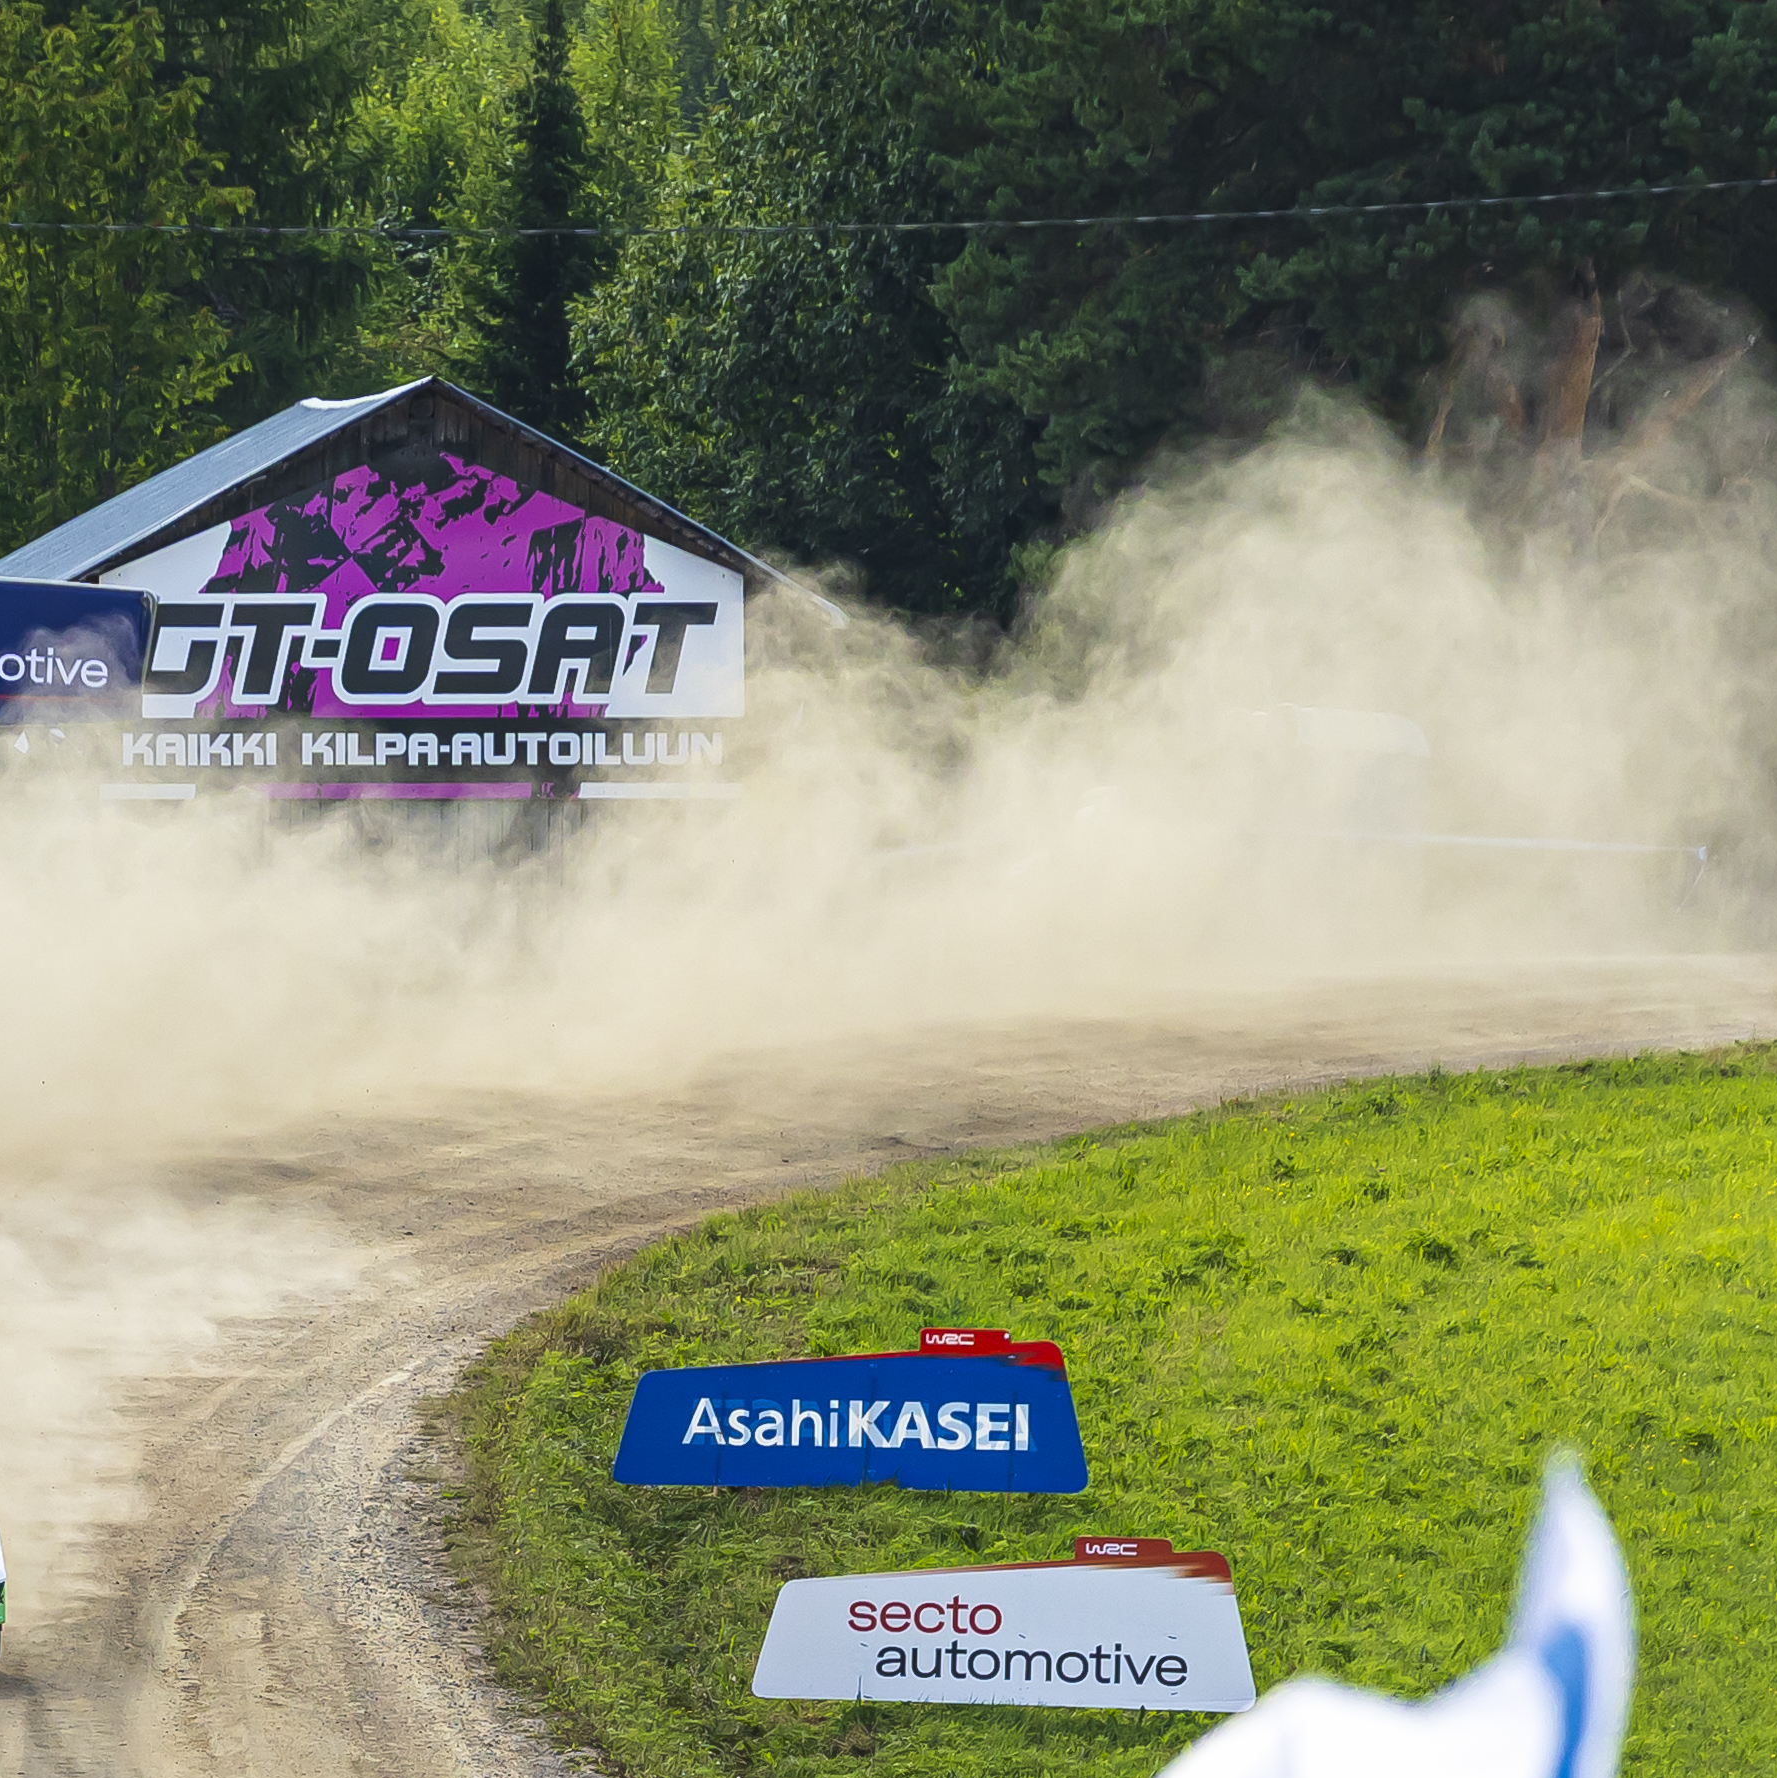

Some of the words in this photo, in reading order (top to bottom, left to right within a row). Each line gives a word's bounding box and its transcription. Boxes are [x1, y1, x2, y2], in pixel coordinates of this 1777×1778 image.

[122, 733, 278, 766] KAIKKI
[302, 732, 724, 766] KILPA-AUTOILUUN
[925, 1332, 975, 1346] WRC
[682, 1397, 1030, 1452] AsahiKASEI
[1085, 1543, 1138, 1556] WRC
[848, 1595, 1002, 1635] secto
[875, 1640, 1188, 1688] automotive
